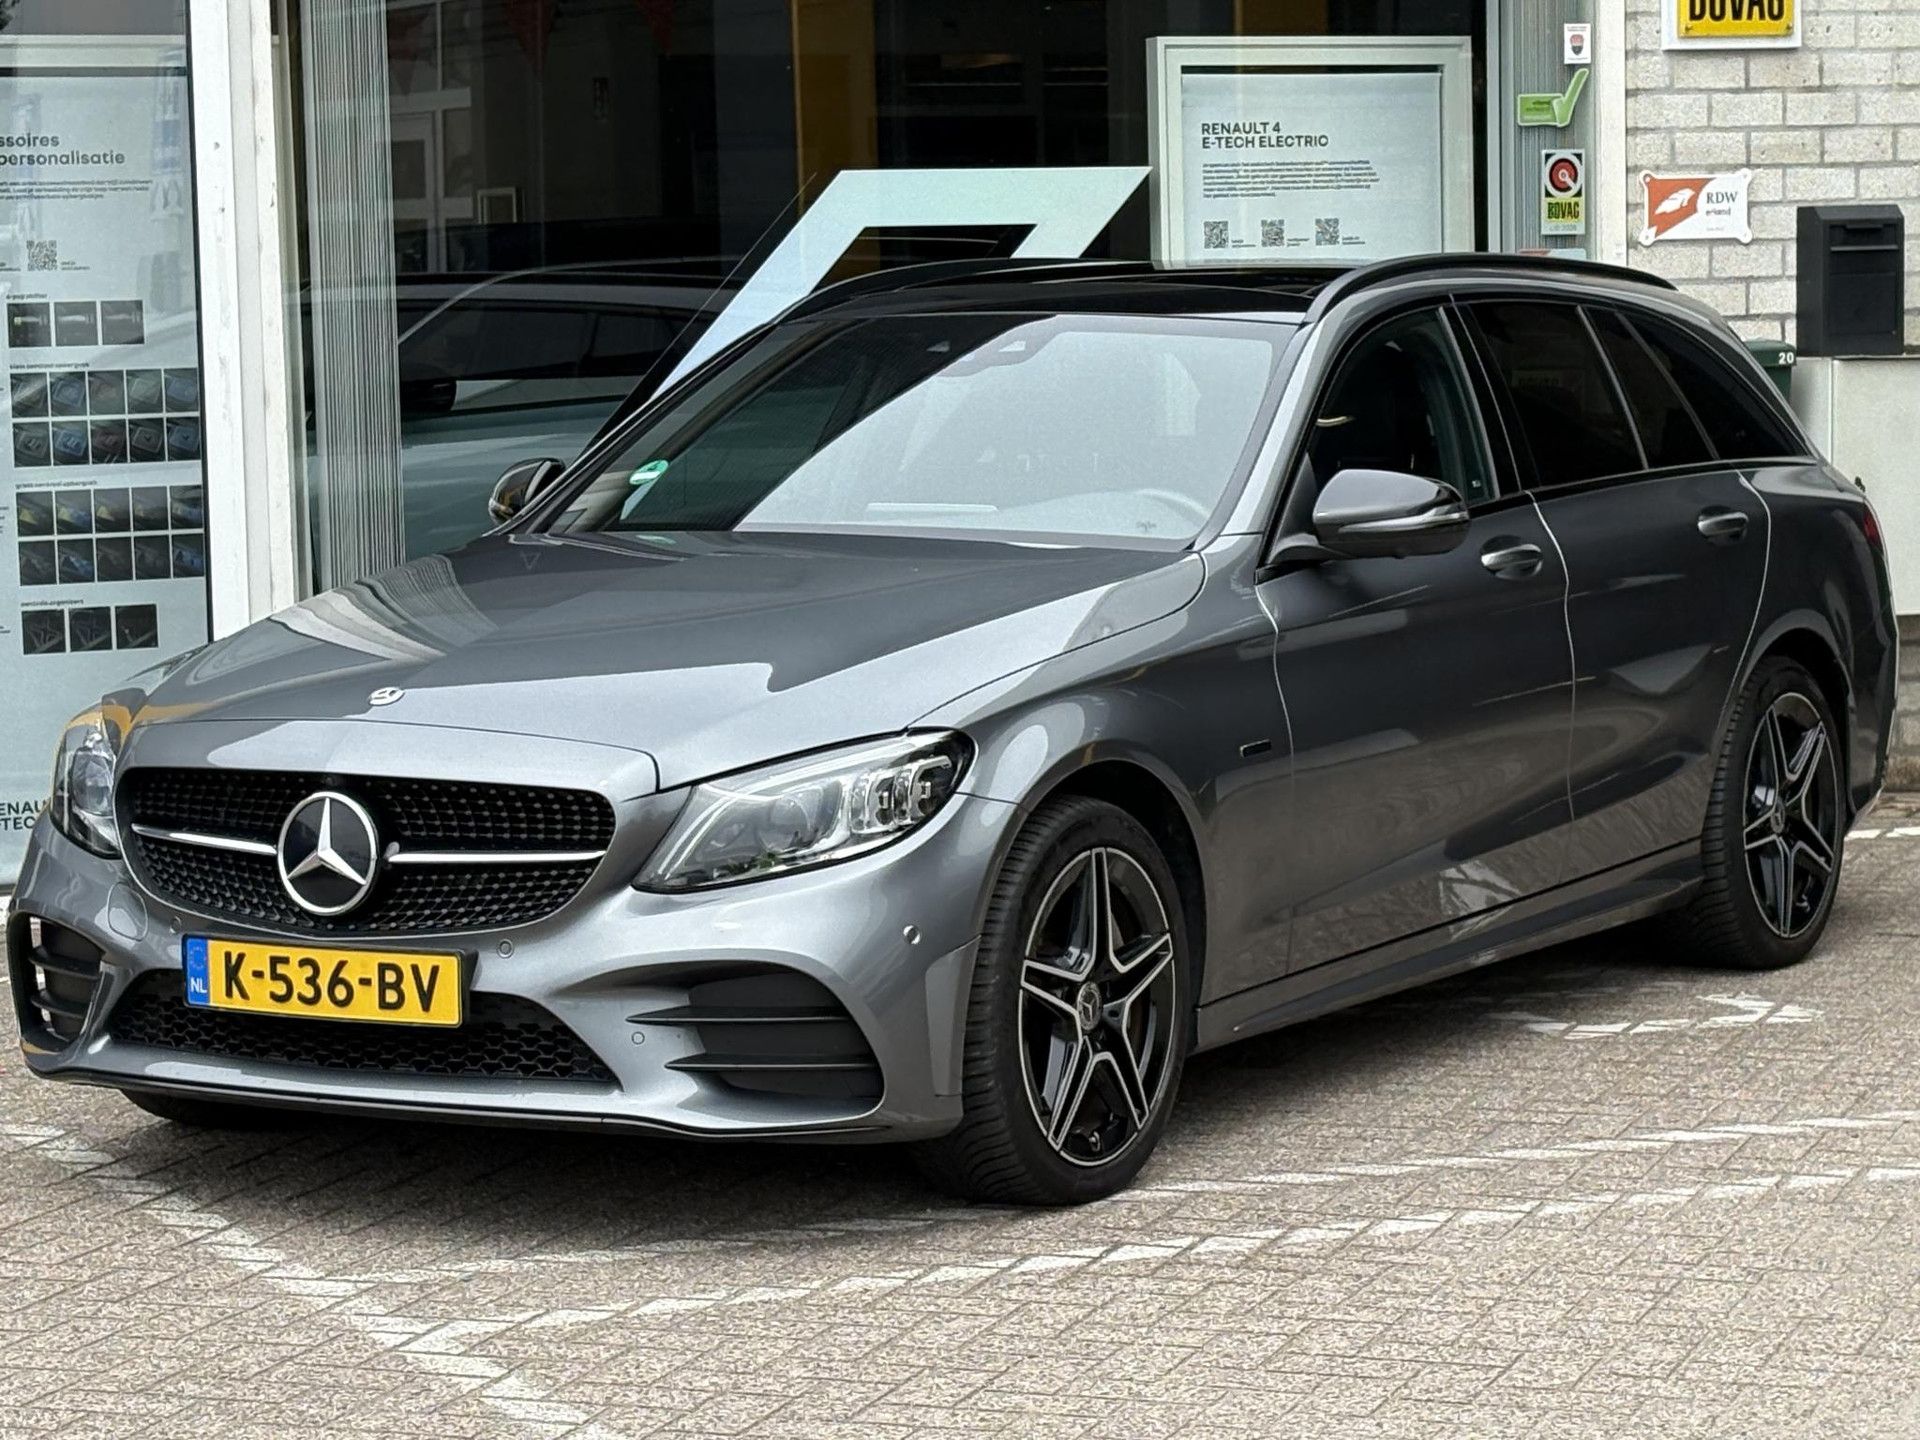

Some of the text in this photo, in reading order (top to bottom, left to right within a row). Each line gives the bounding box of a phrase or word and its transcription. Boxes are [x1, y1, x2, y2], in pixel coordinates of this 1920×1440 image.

[1201, 122, 1281, 135] RENAULT 4
[1202, 136, 1256, 149] E-TECH
[1706, 191, 1738, 204] RDW
[1778, 352, 1794, 365] 20
[0, 816, 36, 831] TEC
[190, 978, 207, 993] NL
[223, 951, 440, 1012] K-536-BV
